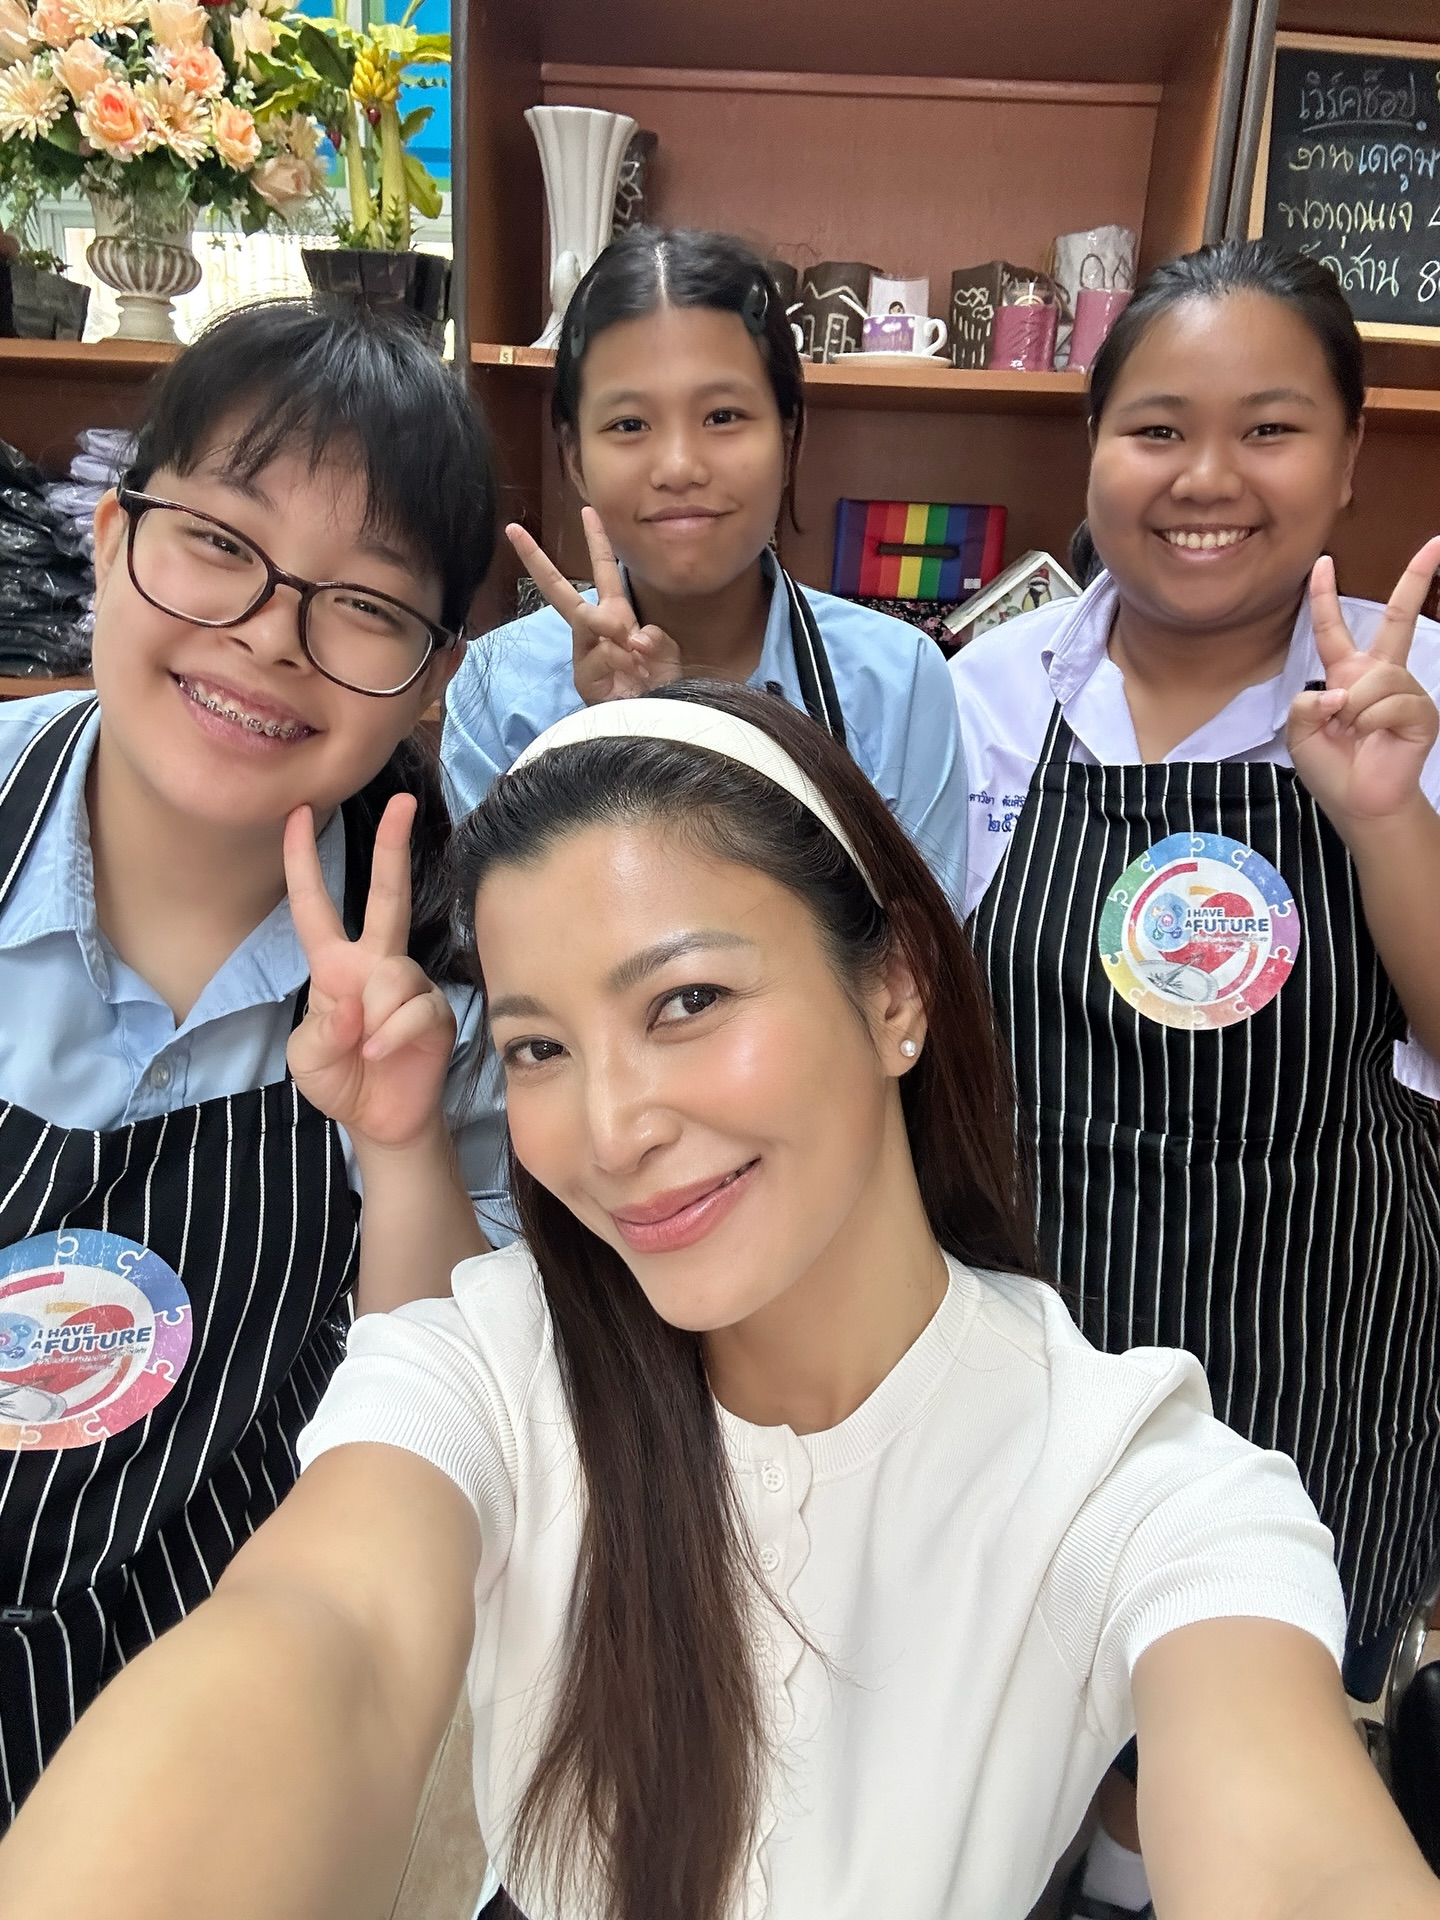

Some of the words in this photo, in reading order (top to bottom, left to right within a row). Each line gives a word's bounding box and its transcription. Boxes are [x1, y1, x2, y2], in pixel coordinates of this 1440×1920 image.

[1417, 260, 1440, 302] 8
[988, 813, 1019, 832] ๒๕
[1193, 909, 1223, 917] HAVE
[1185, 920, 1192, 928] A
[1193, 918, 1269, 932] FUTURE
[47, 1324, 94, 1338] HAVE
[31, 1341, 42, 1349] A
[44, 1326, 152, 1354] FUTURE
